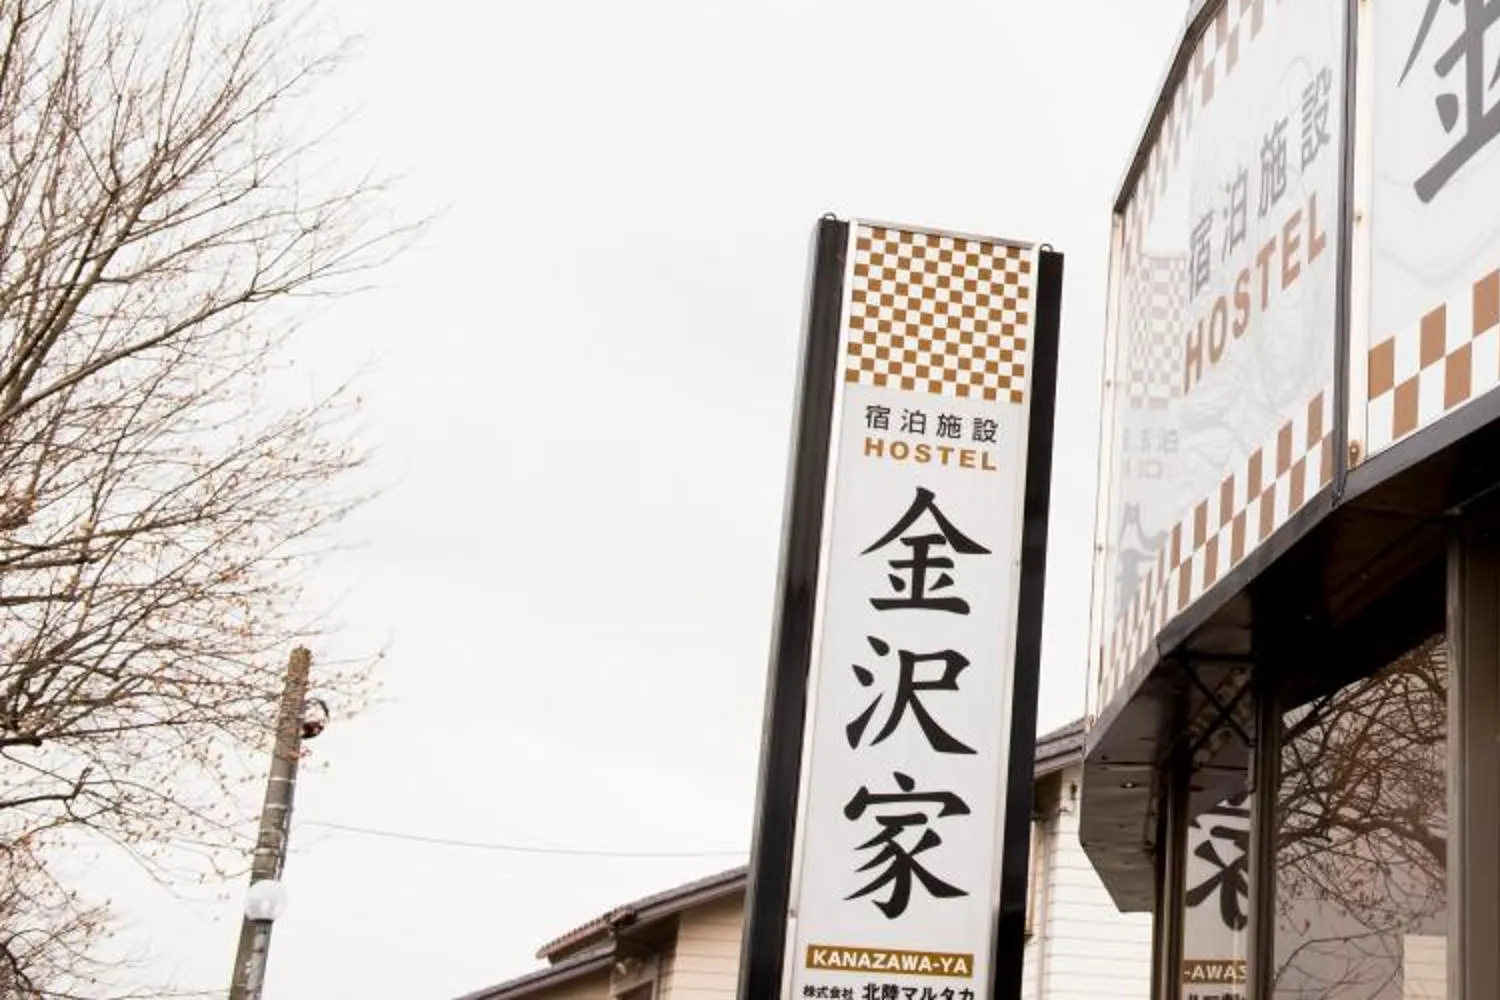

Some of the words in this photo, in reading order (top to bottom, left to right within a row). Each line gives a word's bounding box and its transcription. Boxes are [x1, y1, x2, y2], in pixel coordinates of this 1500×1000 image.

[1187, 66, 1332, 304] 宿泊施設
[1184, 192, 1327, 396] HOSTEL
[863, 437, 998, 471] HOSTEL
[865, 404, 999, 444] 宿泊施設
[843, 486, 993, 920] 金沢家
[812, 949, 969, 974] KANAZAWA-YA
